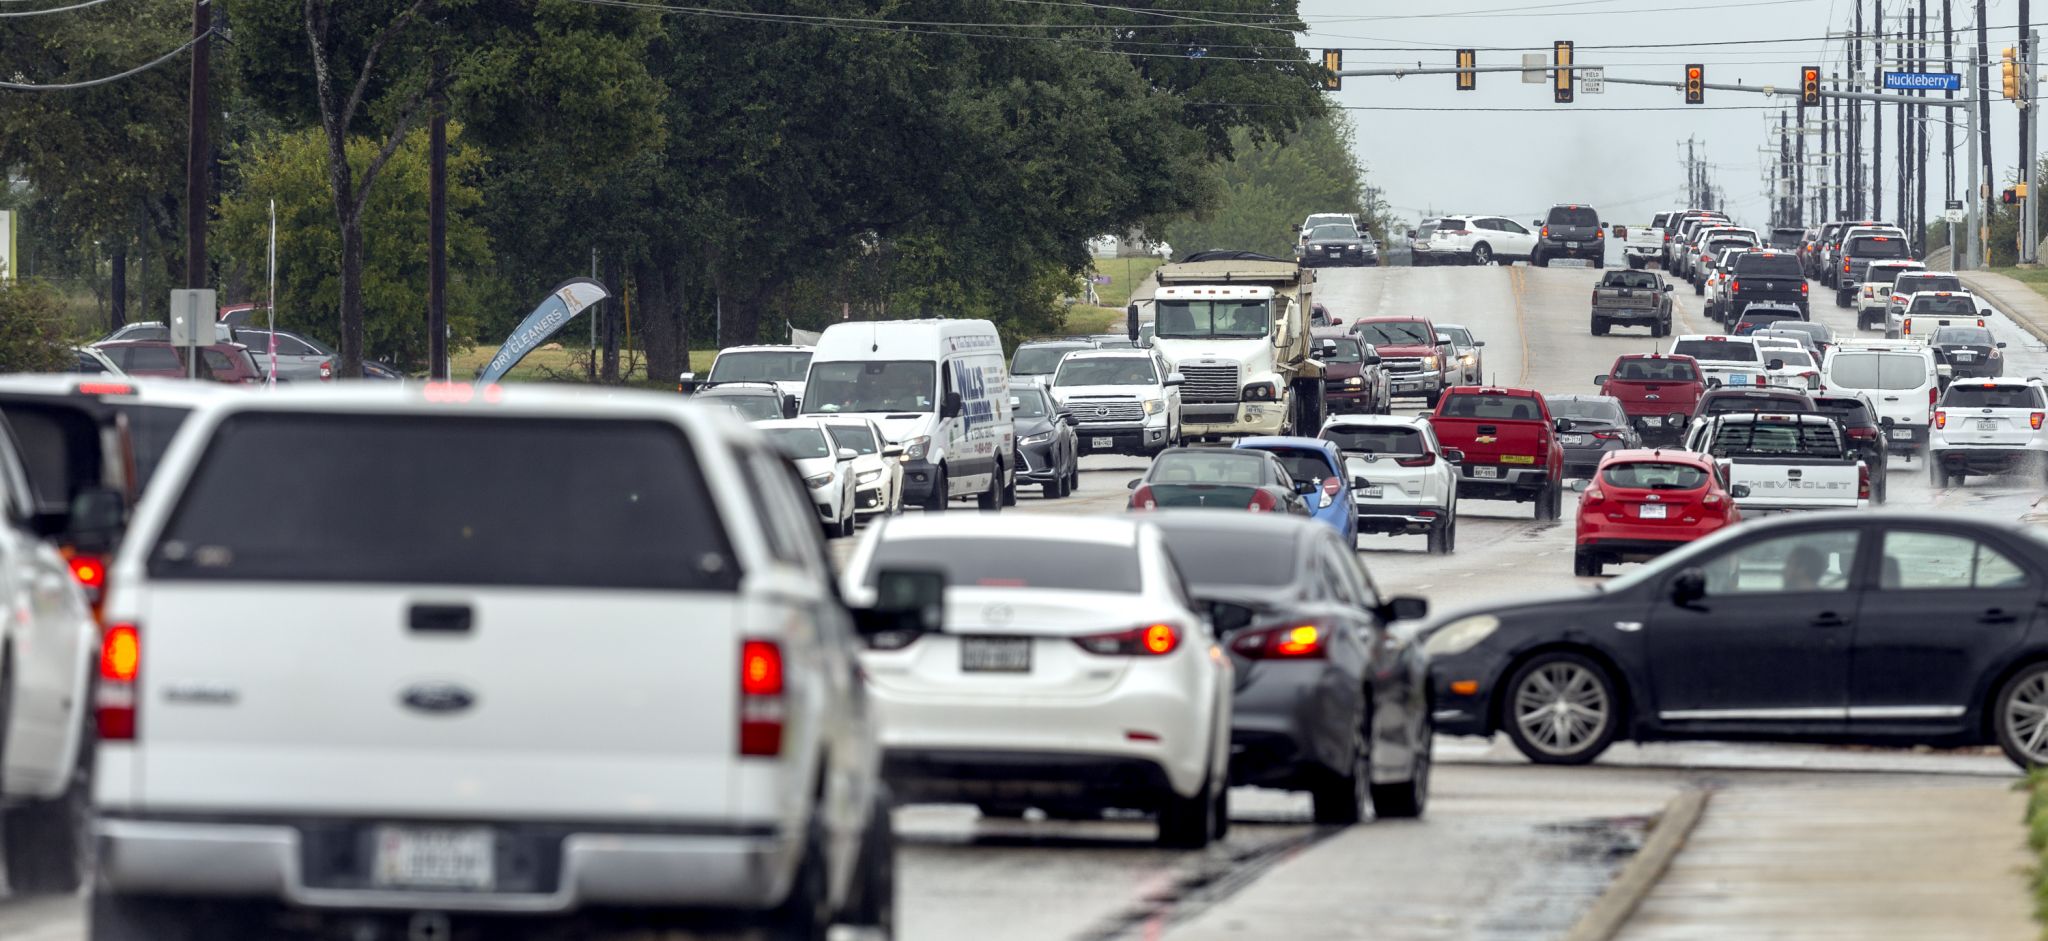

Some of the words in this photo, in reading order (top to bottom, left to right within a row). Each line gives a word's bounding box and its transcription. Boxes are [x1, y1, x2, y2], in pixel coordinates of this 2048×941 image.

[1887, 74, 1949, 88] Huckleberry
[491, 351, 512, 372] DRY
[510, 308, 562, 354] CLEANERS
